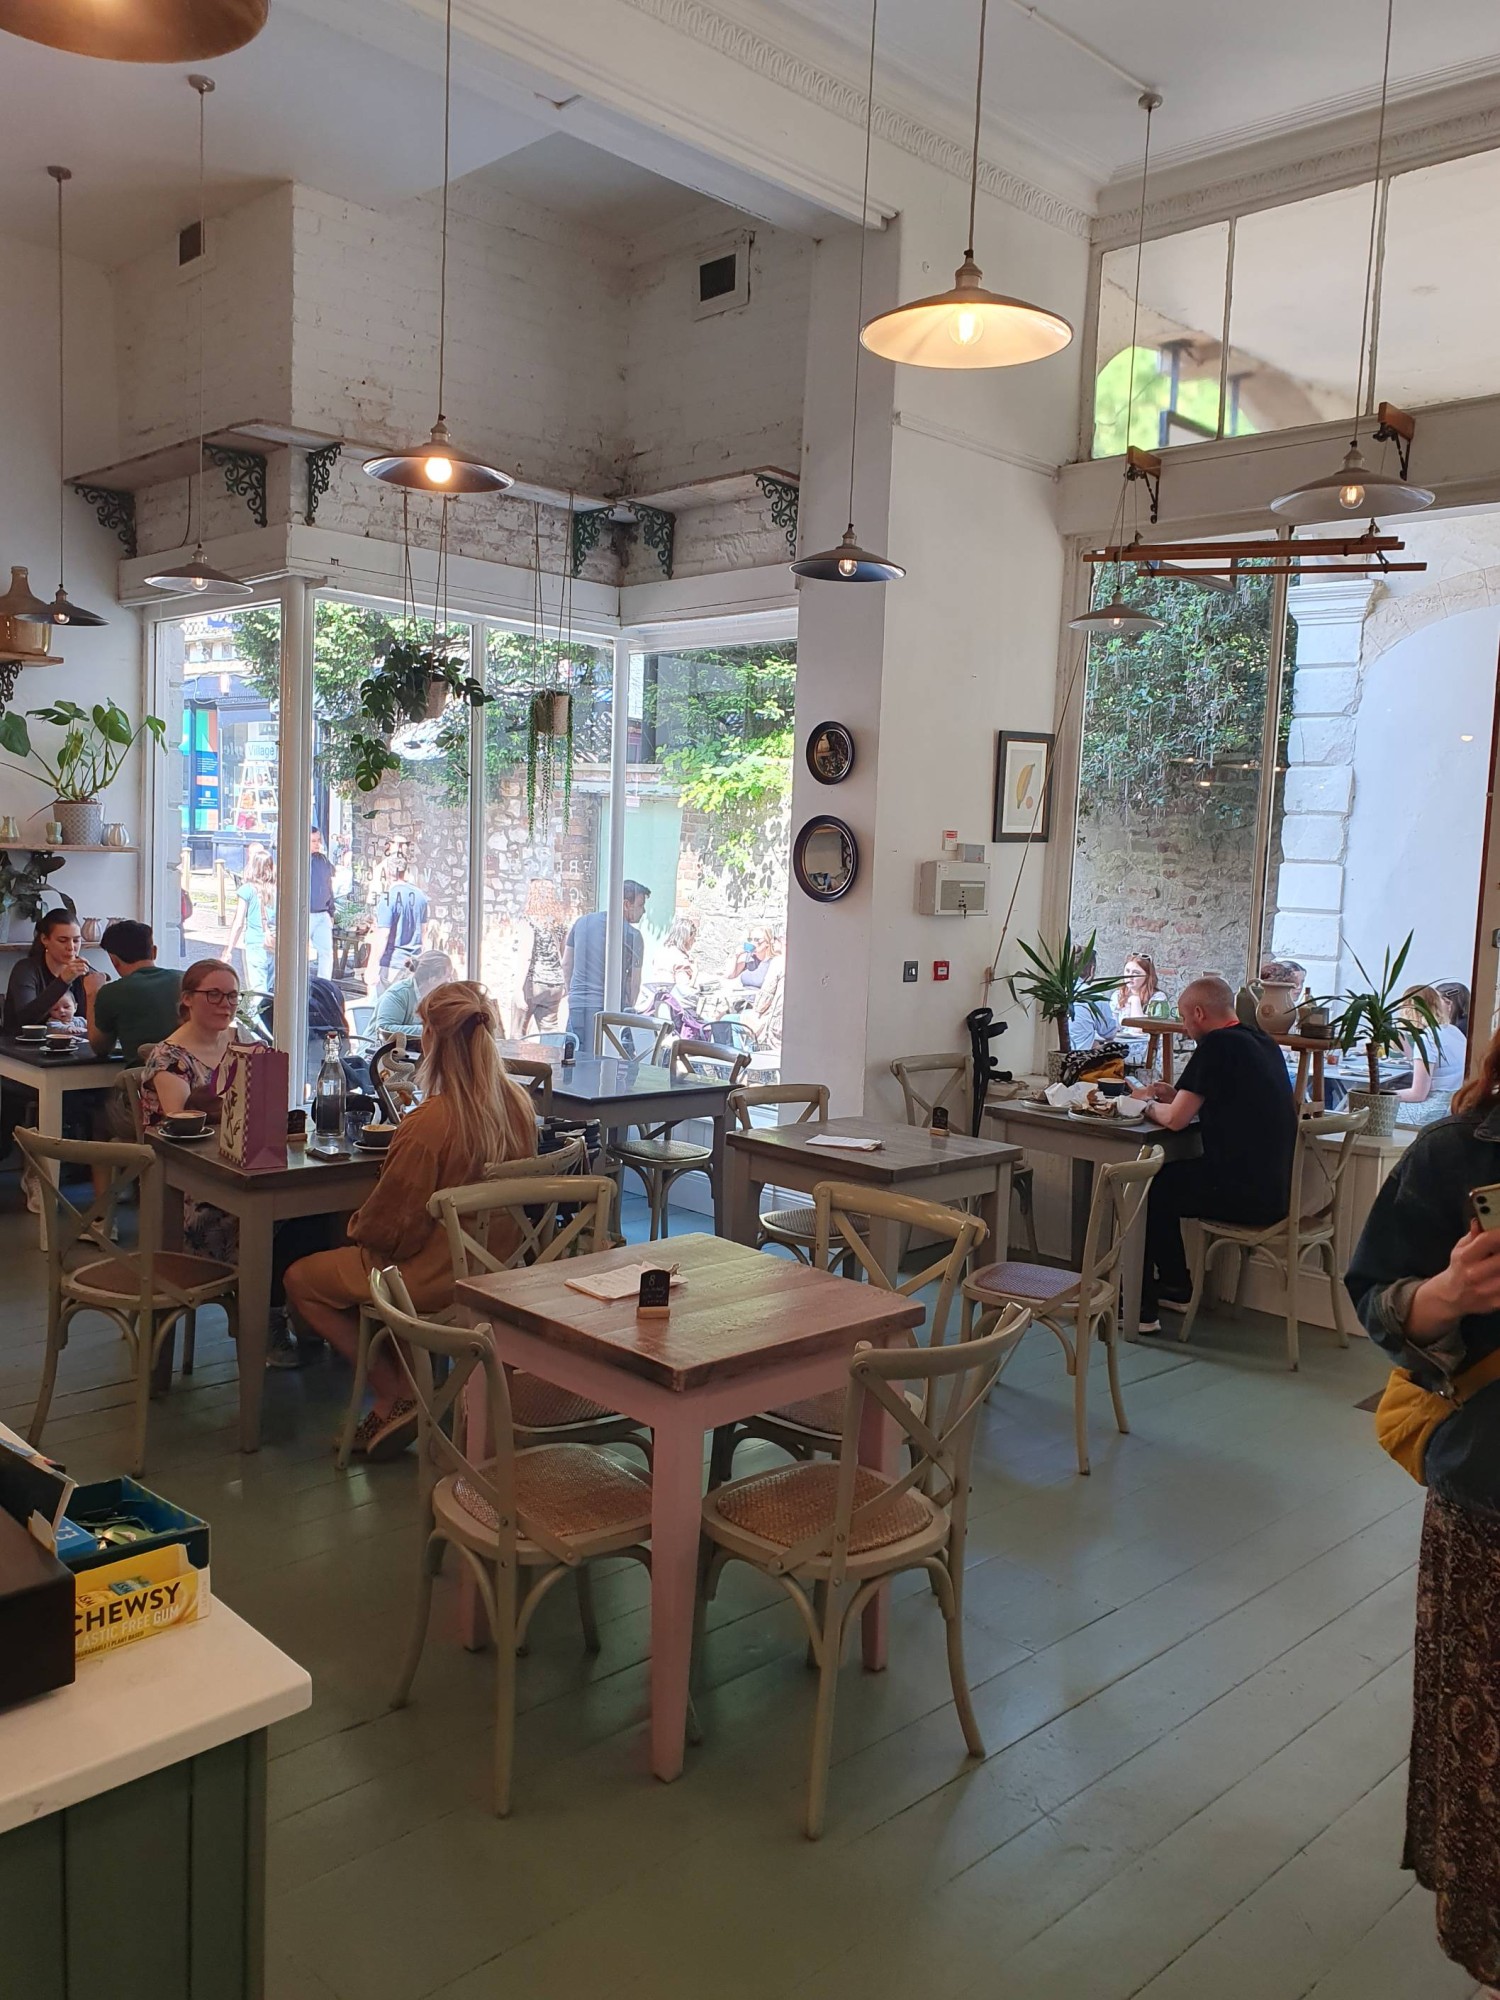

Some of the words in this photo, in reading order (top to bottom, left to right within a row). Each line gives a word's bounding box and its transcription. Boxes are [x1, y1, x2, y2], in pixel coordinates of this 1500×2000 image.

[248, 744, 275, 759] Village
[121, 1613, 151, 1635] FREE
[153, 1604, 181, 1625] GUM
